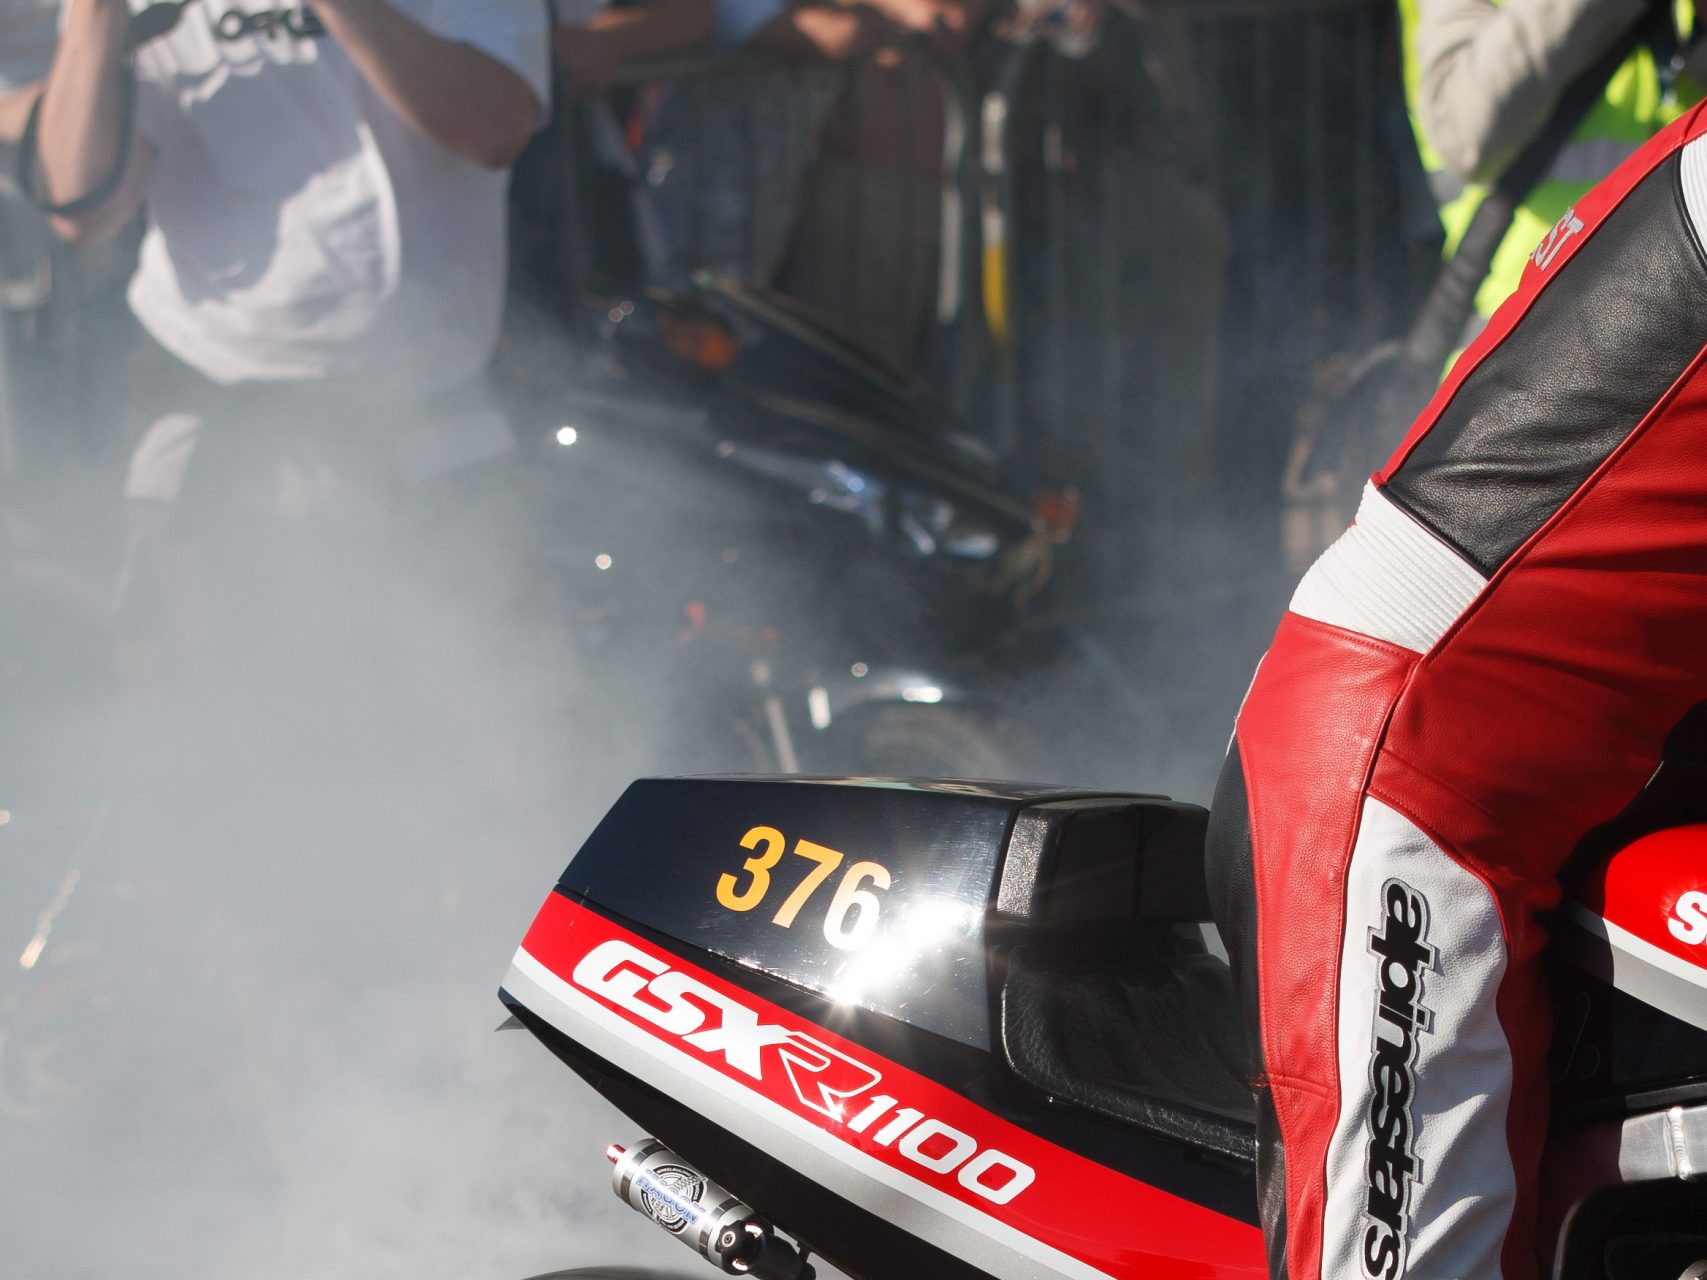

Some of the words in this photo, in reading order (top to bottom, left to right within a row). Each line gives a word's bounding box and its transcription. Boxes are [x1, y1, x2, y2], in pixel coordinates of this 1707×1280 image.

[715, 825, 892, 951] 376
[1667, 890, 1707, 946] S
[846, 1094, 1036, 1205] 1100
